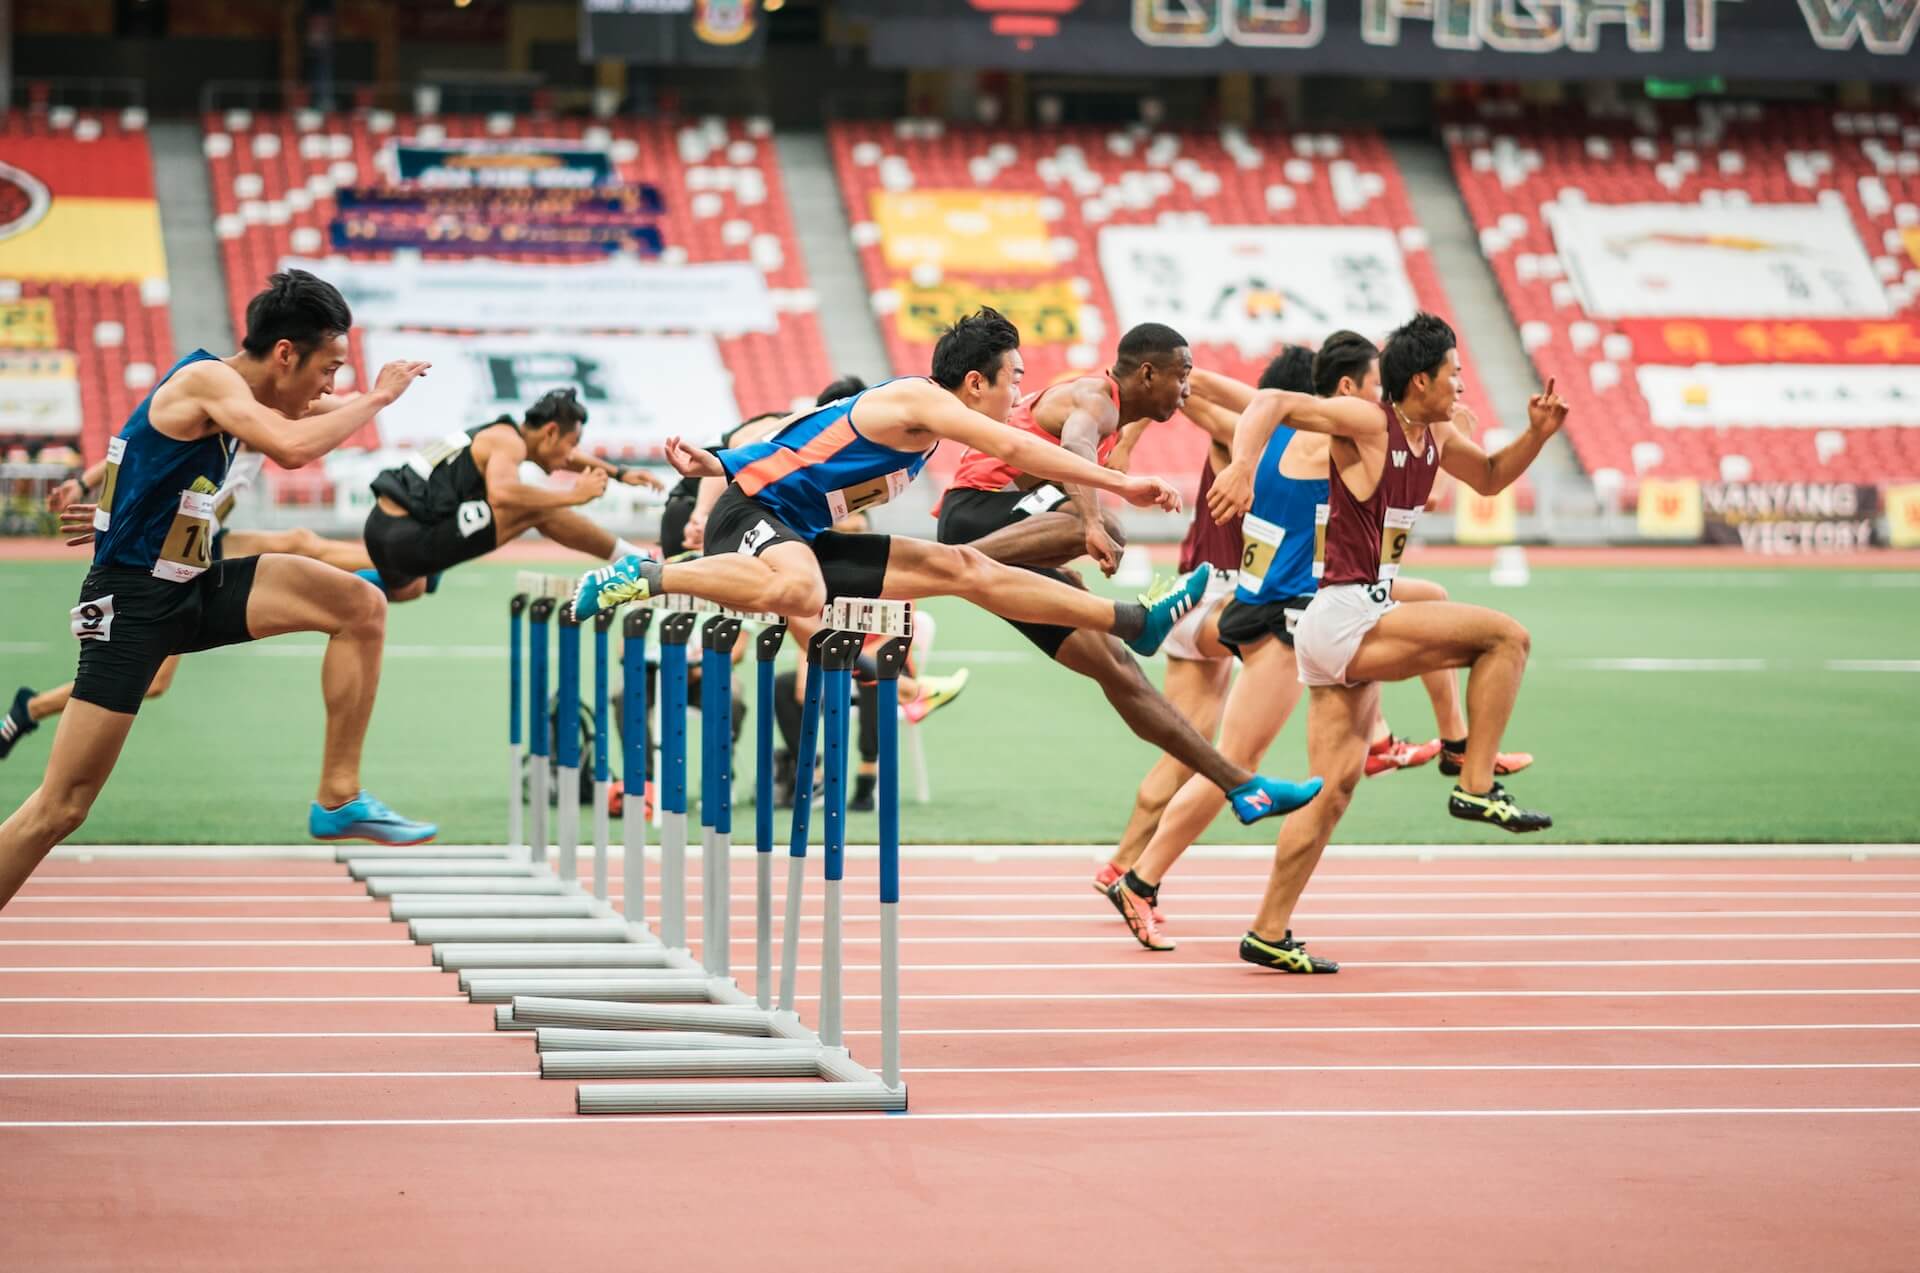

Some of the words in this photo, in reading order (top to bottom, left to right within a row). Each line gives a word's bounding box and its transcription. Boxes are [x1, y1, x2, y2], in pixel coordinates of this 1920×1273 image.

[1391, 450, 1408, 468] W
[1702, 482, 1858, 517] NANYANG
[1737, 518, 1873, 555] VICTORY
[80, 604, 104, 629] 9
